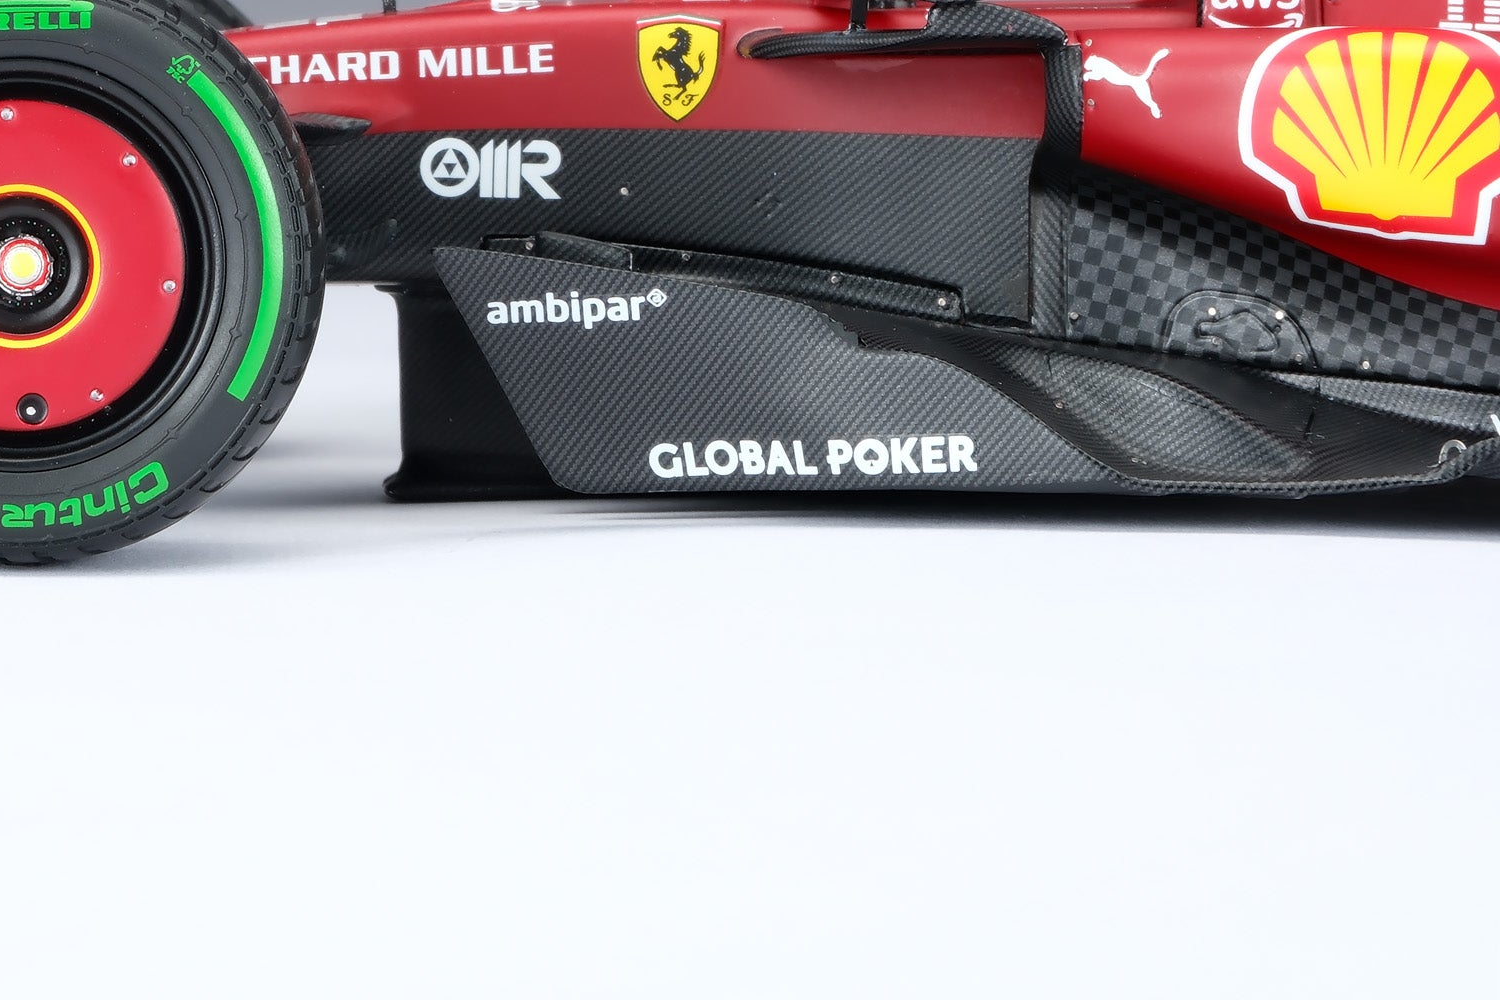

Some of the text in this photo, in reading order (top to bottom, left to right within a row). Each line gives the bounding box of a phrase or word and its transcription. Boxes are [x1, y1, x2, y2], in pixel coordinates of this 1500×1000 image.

[418, 43, 555, 78] MILLE
[486, 290, 646, 330] ambipar
[648, 435, 978, 479] GLOBAL POKER
